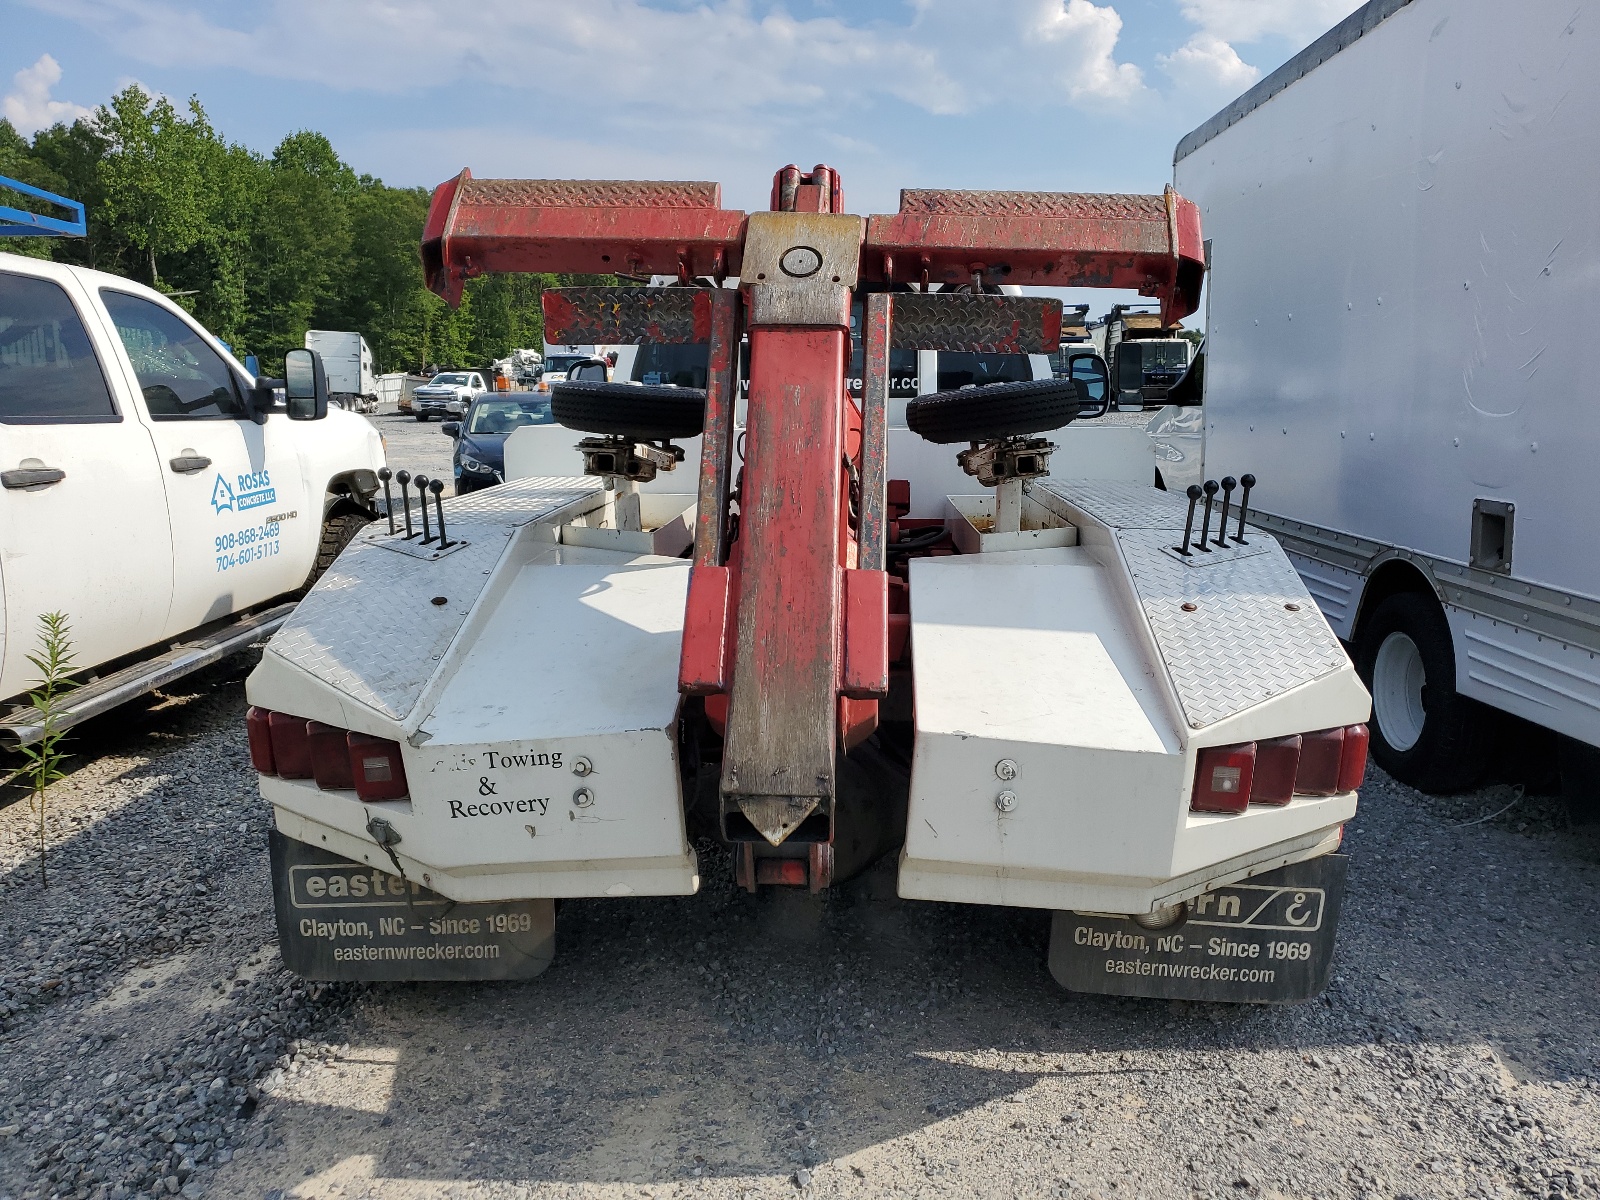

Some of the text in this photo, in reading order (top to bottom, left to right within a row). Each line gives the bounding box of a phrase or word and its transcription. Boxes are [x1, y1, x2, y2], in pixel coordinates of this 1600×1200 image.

[237, 470, 271, 492] ROSAS
[239, 491, 275, 508] CONCRETE LLC
[215, 522, 280, 553] 908-868-2469
[216, 540, 280, 573] 704-601-5113
[482, 749, 563, 769] Towing
[478, 776, 498, 796] &
[447, 797, 550, 819] Recovery
[299, 917, 374, 941] Clayton,
[379, 917, 405, 936] NC
[429, 915, 481, 935] Since
[486, 913, 532, 933] 1969
[333, 942, 500, 962] easternwrecker.com
[1074, 926, 1150, 954] Clayton,
[1157, 935, 1184, 953] NC
[1208, 937, 1260, 958] Since
[1266, 941, 1312, 960] 1969
[1105, 958, 1275, 983] easternwrecker.com
